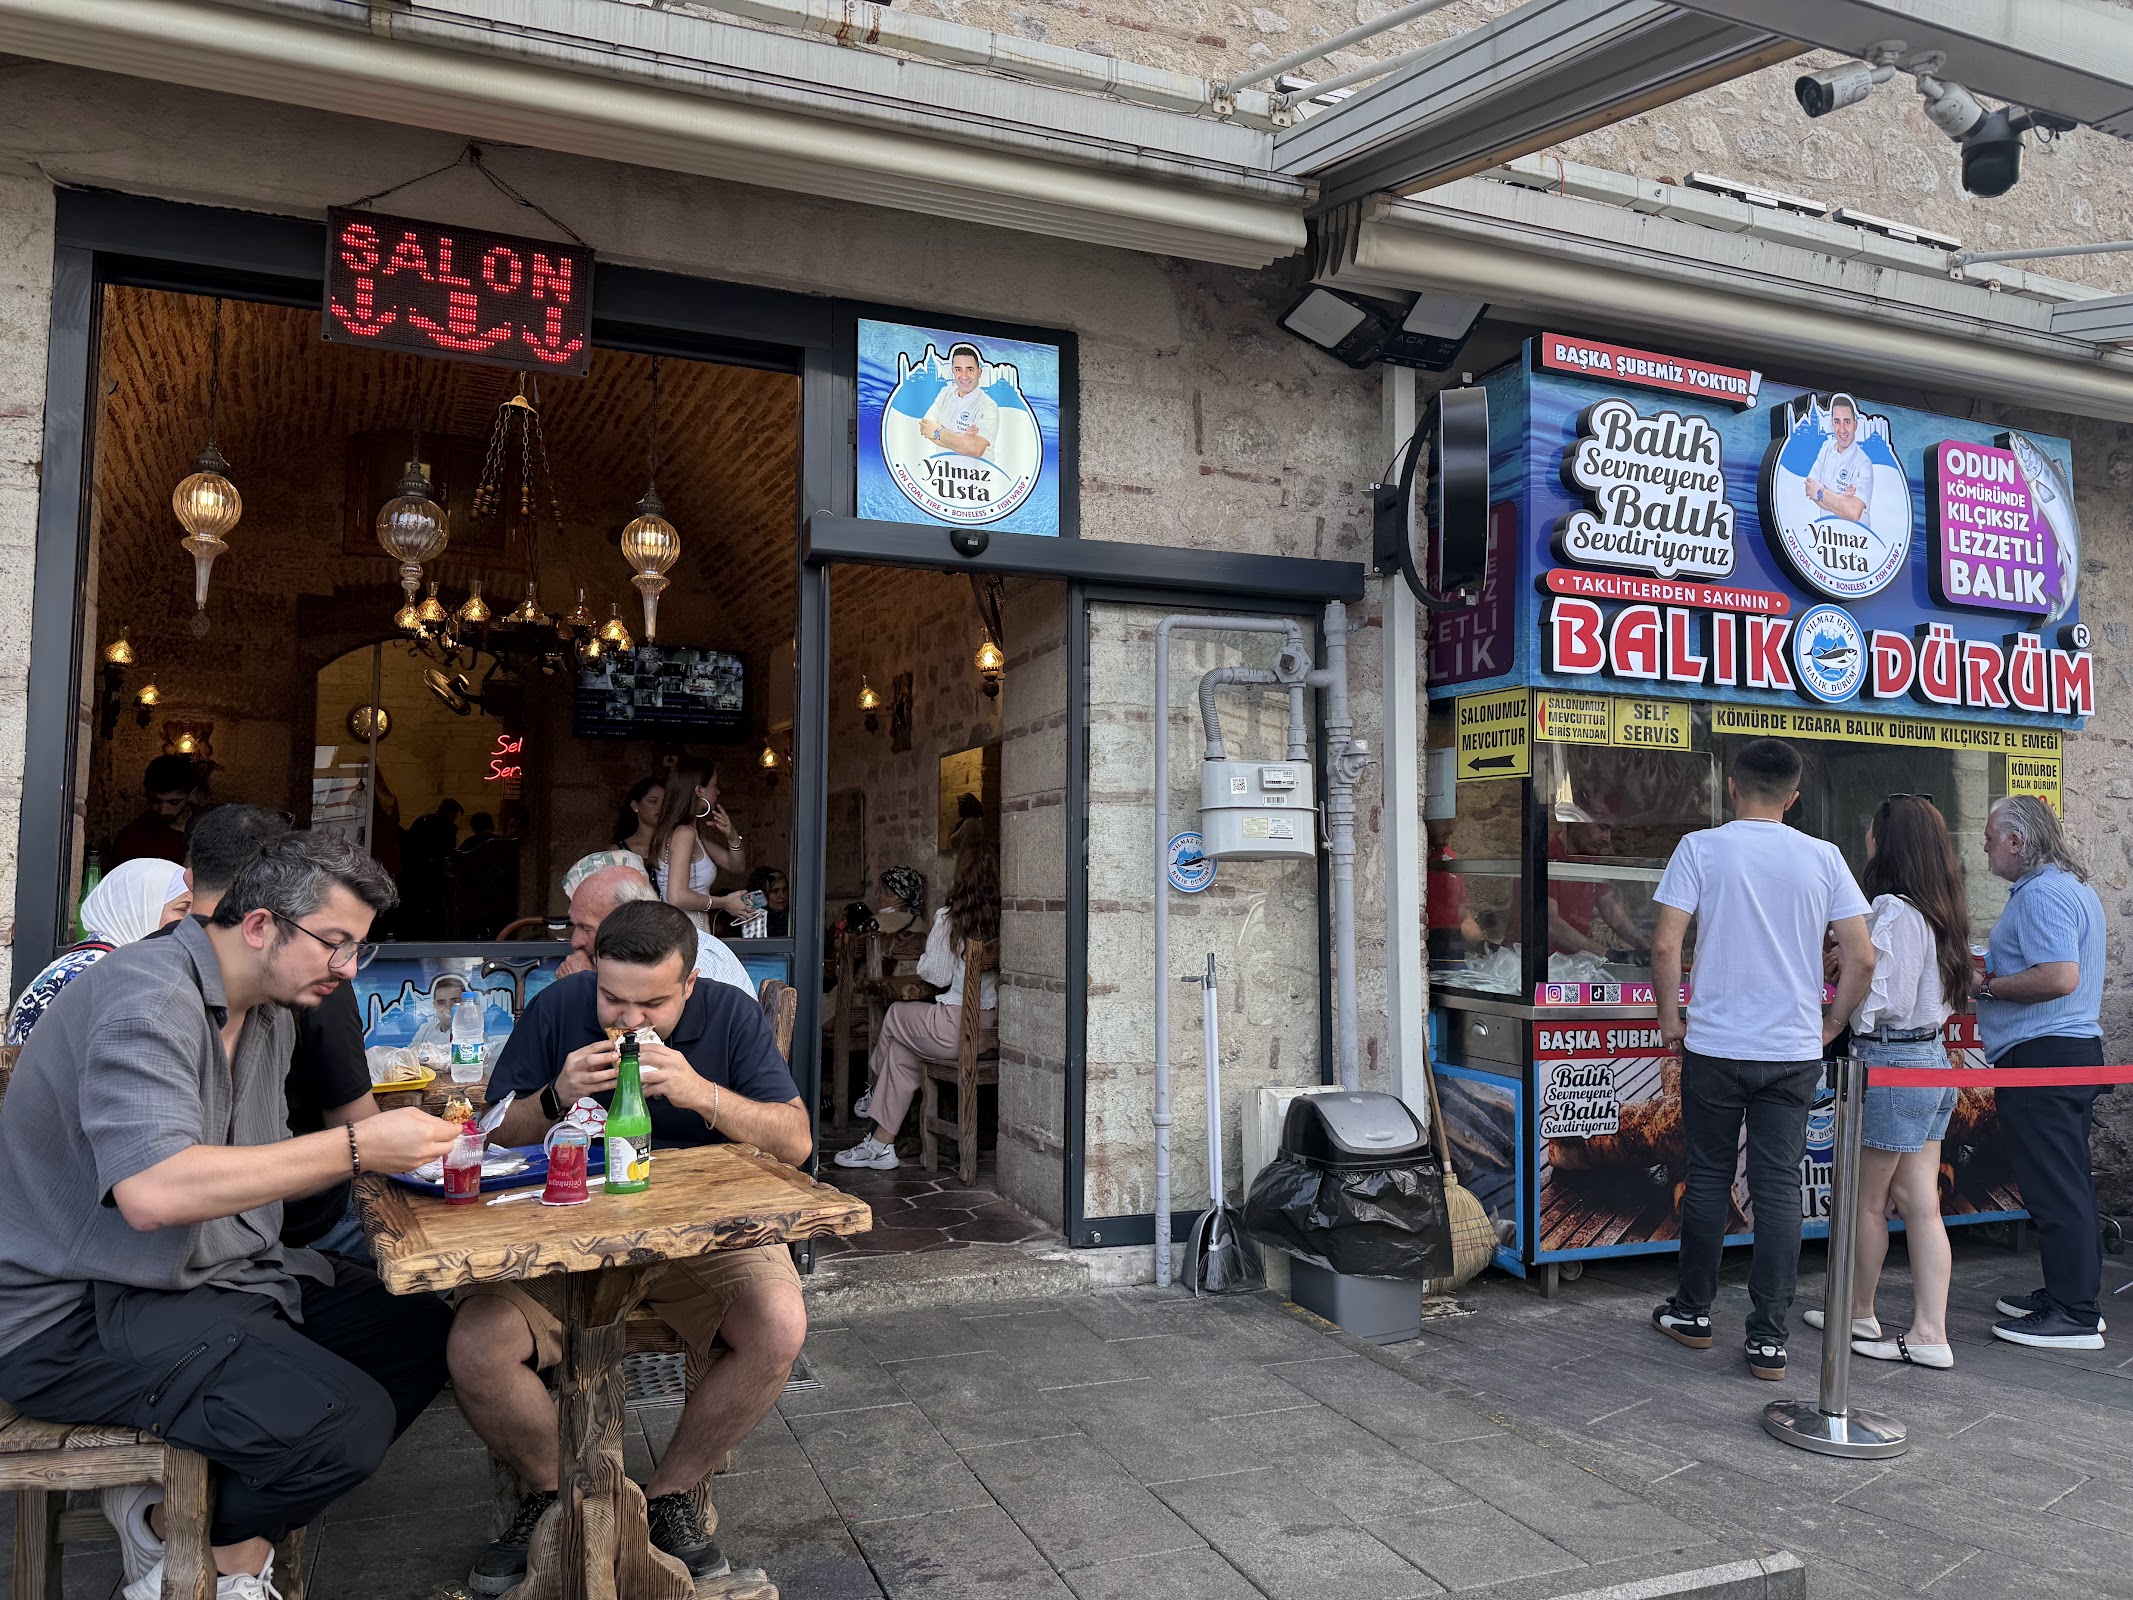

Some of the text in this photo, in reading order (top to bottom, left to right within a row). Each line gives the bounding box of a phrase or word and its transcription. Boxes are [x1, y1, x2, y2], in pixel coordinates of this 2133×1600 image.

[342, 223, 572, 303] SALON
[1555, 344, 1612, 370] BAŞKA
[1616, 356, 1684, 383] ŞUBEMİZ
[1600, 408, 1715, 465] Balık
[921, 459, 991, 482] Yılmaz
[1583, 447, 1719, 495] Sevmeyene
[1946, 449, 2015, 484] ODUN
[898, 469, 1027, 518] ON COAL FIRE BONELESS FISH WRAP
[932, 478, 991, 501] Usta
[1947, 479, 2025, 508] KÖMÜRÜNDE
[1607, 484, 1730, 540] Balık
[1947, 501, 2029, 531] KILÇIKSIZ
[1573, 521, 1729, 567] Sevdiriyoruz
[1808, 523, 1868, 549] Yılmaz
[1948, 528, 2043, 565] LEZZETLİ
[1788, 535, 1900, 591] ON COAL FIRE BONELESS FISH WRAP
[1817, 546, 1869, 572] Usta
[1573, 576, 1769, 610] TAKLİTLERDEN SAKININ
[1949, 559, 2047, 606] BALIK
[1805, 614, 1855, 640] YILMAZ USTA
[1550, 596, 1796, 691] BALIK
[1429, 635, 1496, 681] LIK
[1870, 621, 2095, 715] DÜRÜM
[1805, 665, 1857, 692] BALIK DÜRÜM
[1461, 698, 1527, 725] SALONUMUZ
[1548, 697, 1605, 712] SALONUMUZ
[1633, 703, 1669, 721] SELF
[1548, 712, 1605, 726] MEVCUTTUR
[1717, 708, 2058, 750] KÖMÜRDE IZGARA BALIK DÜRÜM KILÇIKSIZ EL EMEĞİ
[491, 735, 523, 755] Sel
[1462, 727, 1525, 752] MEVCUTTUR
[1548, 725, 1606, 740] GİRİŞ YANDAN
[1623, 723, 1679, 744] SERVİS
[2011, 760, 2057, 777] KÖMÜRDE
[2011, 779, 2057, 790] BALIK DÜRÜM
[1172, 838, 1194, 852] YILMAZ
[1539, 1029, 1664, 1055] BAŞKA ŞUBEM
[1556, 1068, 1611, 1088] Balık
[1548, 1087, 1613, 1102] Sevmeyene
[1560, 1101, 1617, 1120] Balık
[1544, 1120, 1617, 1135] Sevdiriyoruz
